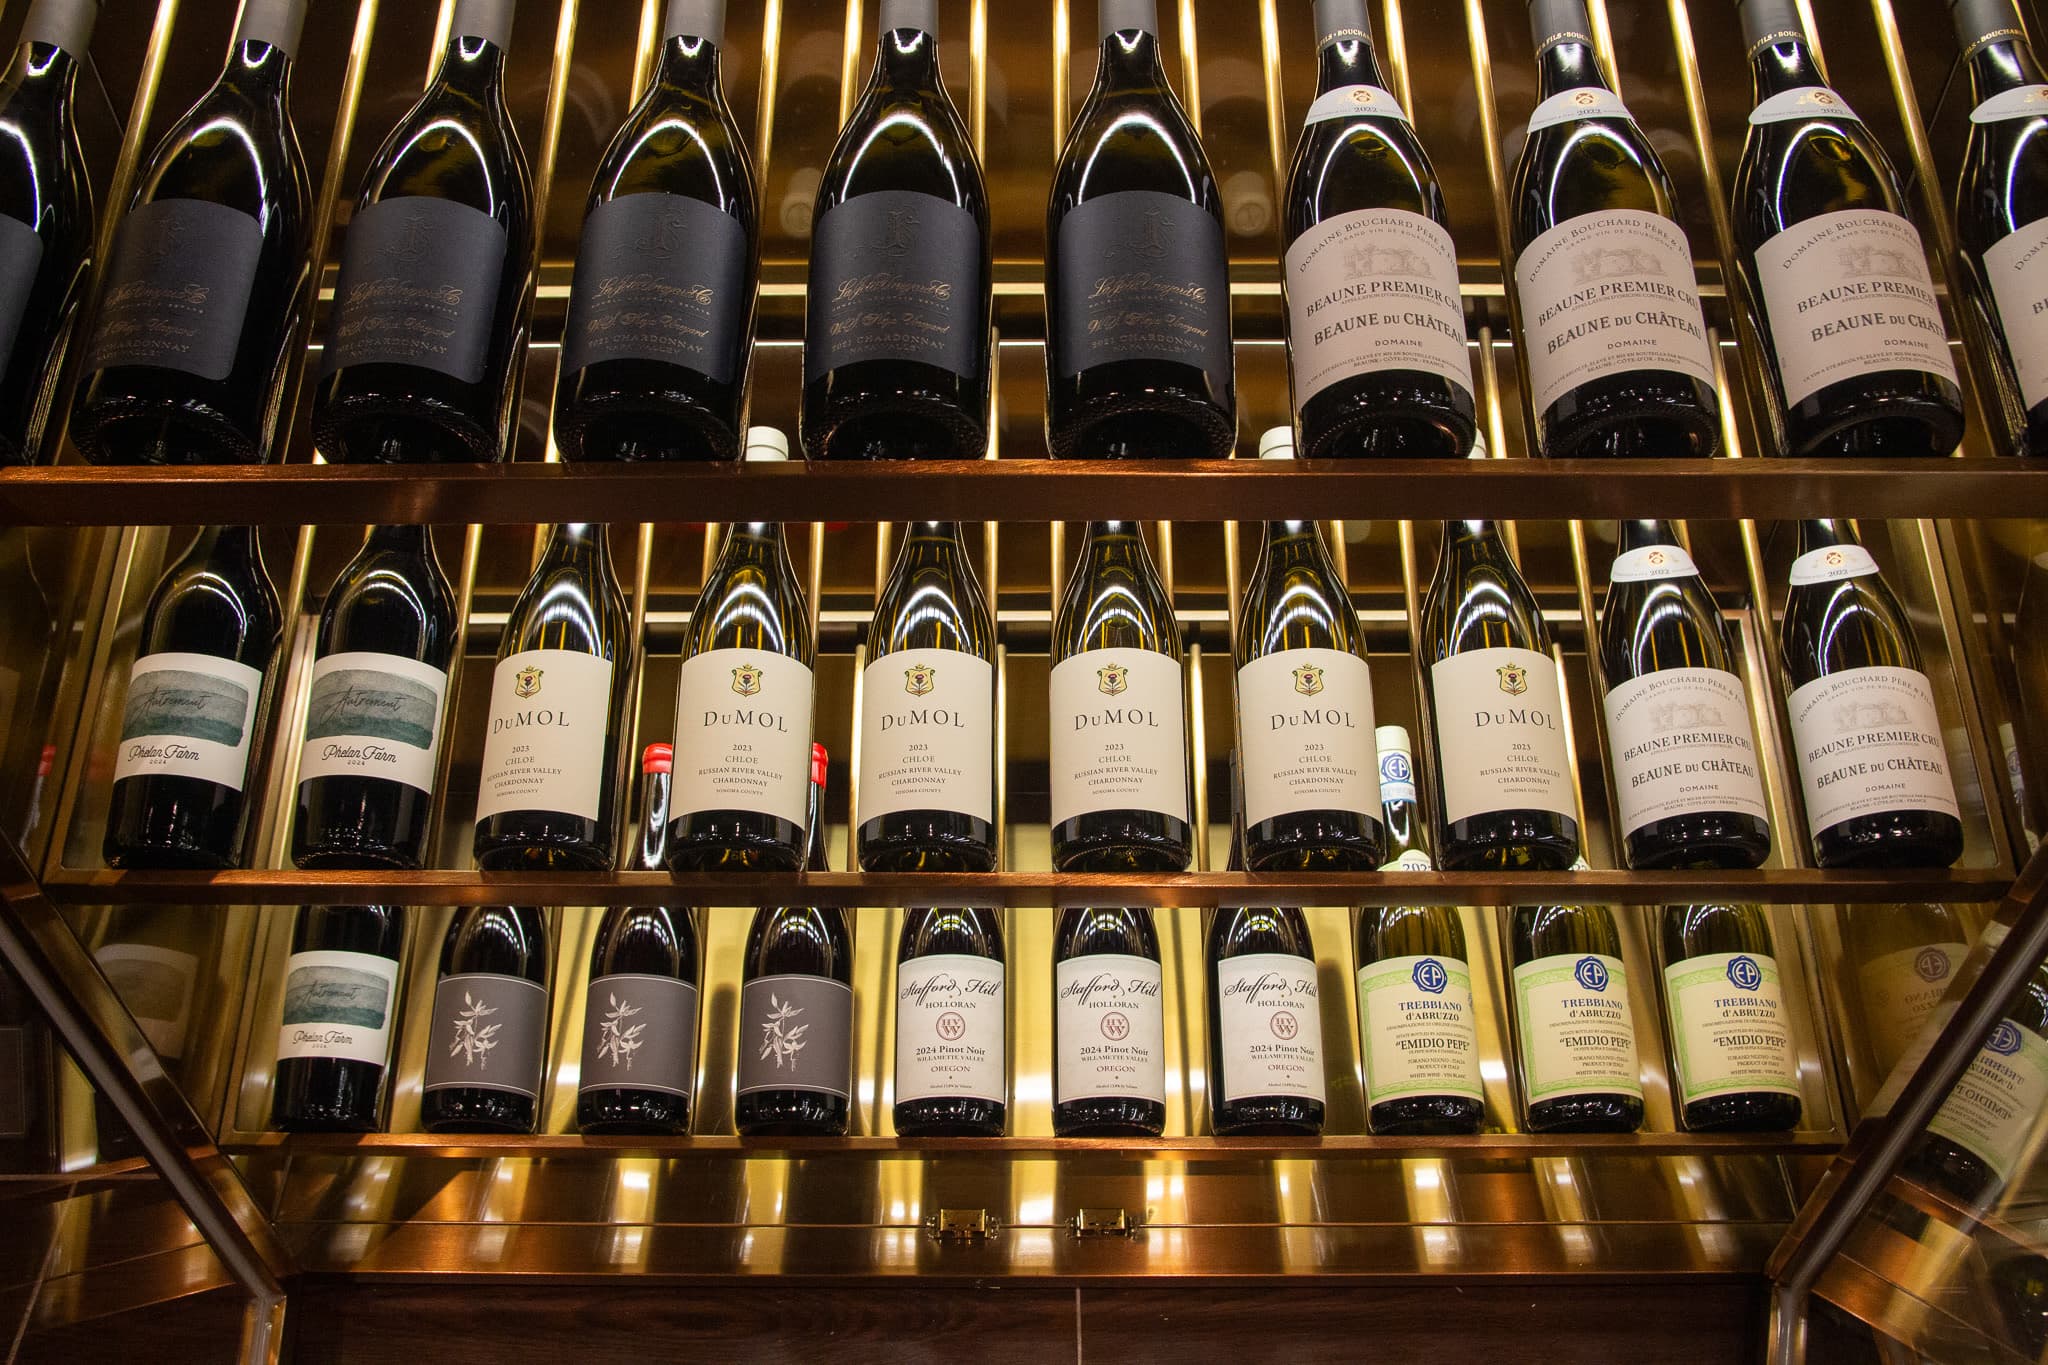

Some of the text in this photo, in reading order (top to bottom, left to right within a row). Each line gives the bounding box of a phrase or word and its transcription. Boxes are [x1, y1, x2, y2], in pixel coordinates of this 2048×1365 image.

[1299, 217, 1412, 273] DOMAINE BOUCHARD
[1783, 219, 1901, 270] DOMAINE BOUCHARD
[1530, 236, 1569, 282] DOMAINE
[1571, 219, 1641, 238] BOUCHARD
[1306, 283, 1367, 317] BEAUNE
[1370, 280, 1443, 302] PREMIER
[1797, 282, 1868, 313] BEAUNE
[1539, 281, 1676, 326] BEAUNE PREMIER
[1314, 313, 1379, 345] BEAUNE
[1403, 312, 1464, 346] CHÂTEAU
[1547, 317, 1610, 354] BEAUNE
[1636, 311, 1701, 340] CHÂTEAU
[1810, 313, 1886, 342] BEAUNE
[1375, 339, 1423, 347] DOMAINE
[1607, 339, 1657, 350] DOMAINE
[1884, 339, 1928, 350] DOMAINE
[1616, 676, 1705, 721] DOMAINE BOUCHARD
[1800, 675, 1888, 722] DOMAINE BOUCHARD
[512, 745, 530, 754] 2023
[1624, 736, 1670, 762] BEAUNE
[1673, 732, 1734, 745] PREMIER
[1808, 737, 1855, 763] BEAUNE
[1857, 731, 1921, 745] PREMIER
[128, 744, 200, 762] Phelan Farm
[322, 744, 397, 763] Phelan Farm
[505, 756, 535, 766] CHLOE
[725, 755, 759, 764] CHLOE
[902, 755, 935, 764] CHLOE
[1098, 755, 1132, 763] CHLOE
[1298, 755, 1332, 764] CHLOE
[1507, 755, 1539, 763] CHLOE
[732, 767, 755, 775] RIVER
[757, 769, 782, 781] VALLEY
[934, 767, 962, 776] VALLEY
[1131, 767, 1158, 775] VALLEY
[1332, 767, 1357, 776] VALLEY
[1539, 767, 1561, 777] VALLEY
[1631, 763, 1682, 788] BEAUNE
[1702, 759, 1754, 778] CHÂTEAU
[1816, 763, 1868, 789] BEAUNE
[1887, 757, 1943, 776] CHÂTEAU
[494, 778, 544, 789] CHARDONNAY
[712, 778, 768, 787] CHARDONNAY
[891, 777, 946, 786] CHARDONNAY
[1088, 777, 1144, 786] CHARDONNAY
[1289, 777, 1344, 786] CHARDONNAY
[1498, 777, 1550, 785] CHARDONNAY
[1680, 784, 1719, 793] DOMAINE
[1866, 783, 1906, 793] DOMAINE
[901, 973, 1002, 1007] Stafford Hill
[1061, 973, 1160, 1006] Stafford Hill
[1224, 972, 1317, 1005] Stafford Hill
[925, 1001, 976, 1009] HOLLORAN
[1089, 1001, 1139, 1009] HOLLORAN
[1257, 1000, 1305, 1009] HOLLORAN
[1398, 1000, 1462, 1012] TREBBIANO
[1561, 999, 1623, 1009] TREBBIANO
[1713, 998, 1777, 1008] TREBBIANO
[1406, 1012, 1460, 1022] d'ABRUZZO
[1569, 1010, 1621, 1020] d'ABRUZZO
[1722, 1009, 1775, 1018] d'ABRUZZO
[292, 1030, 352, 1044] Phelan Farm
[916, 1045, 986, 1056] 2024 Pinot Noir
[1080, 1045, 1149, 1056] 2024 Pinot Noir
[1250, 1045, 1272, 1053] 2024
[1275, 1044, 1298, 1053] Pinot
[1268, 1064, 1305, 1072] OREGON
